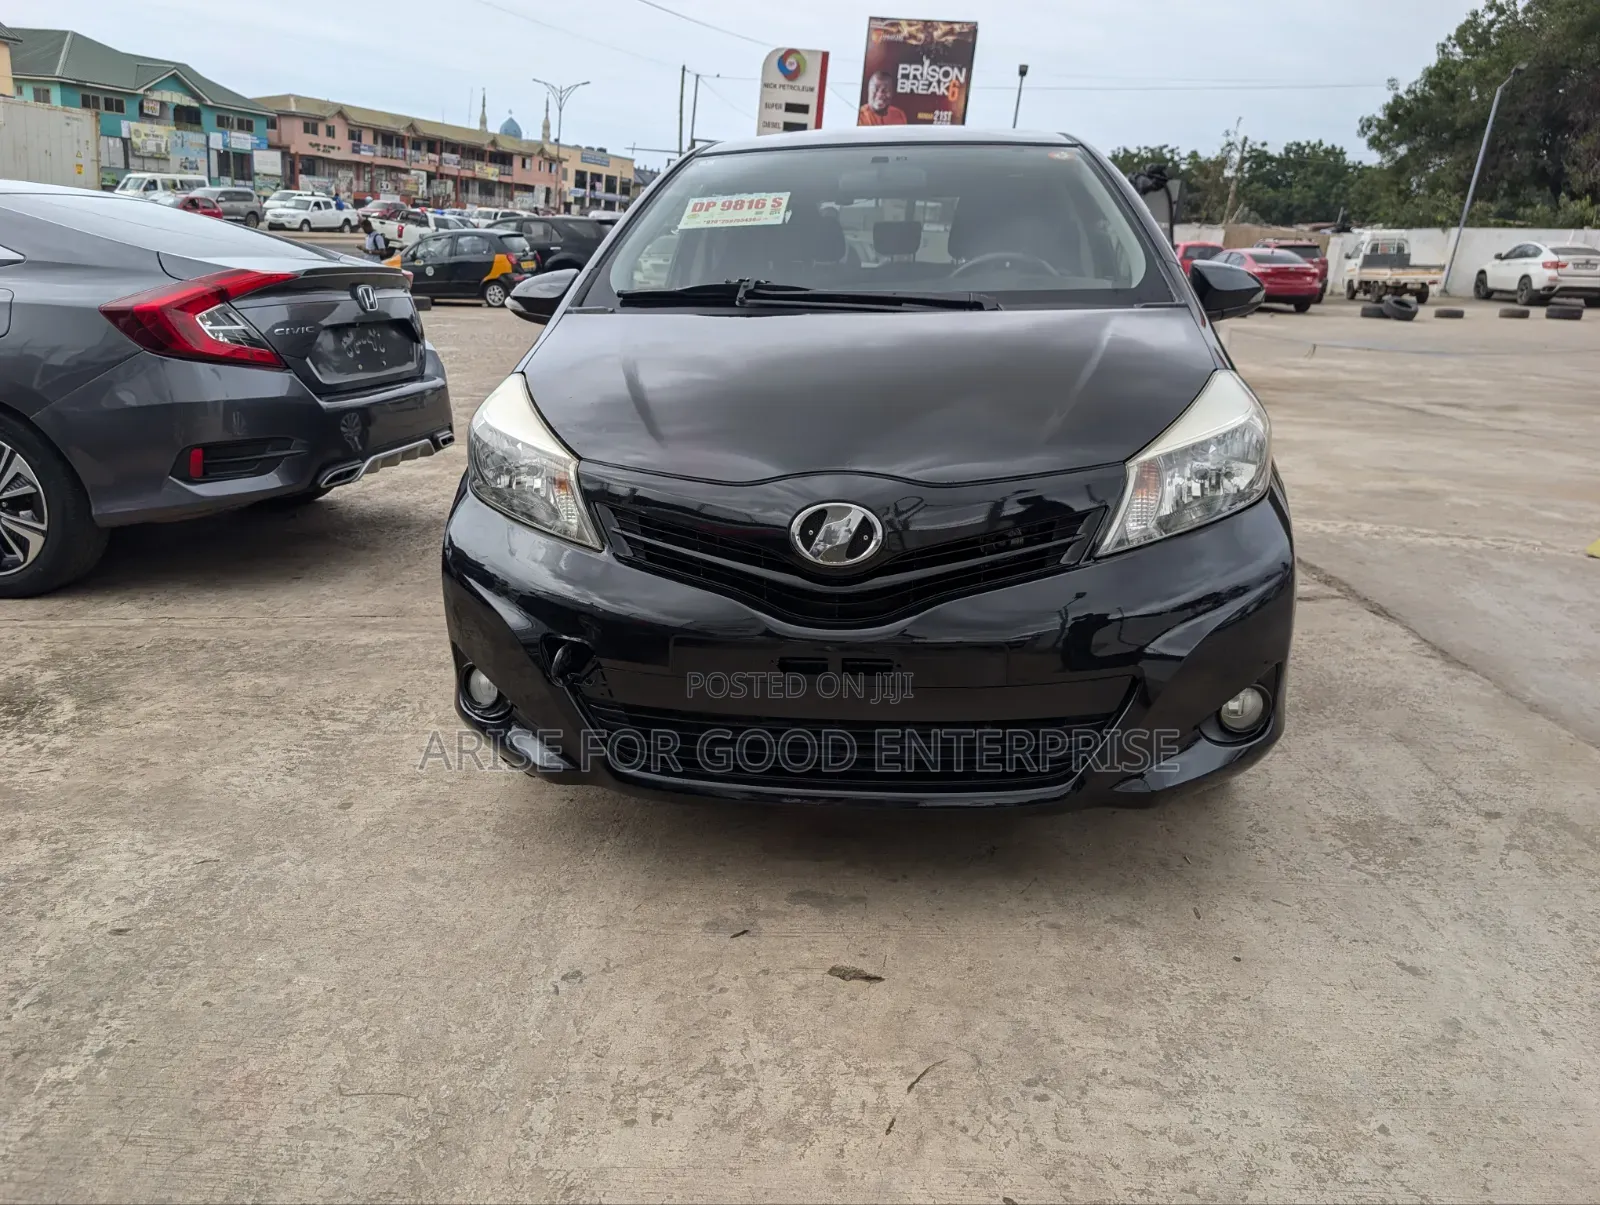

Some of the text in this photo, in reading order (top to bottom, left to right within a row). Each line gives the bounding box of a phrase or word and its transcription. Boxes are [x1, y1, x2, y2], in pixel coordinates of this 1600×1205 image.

[897, 58, 966, 83] PRISON
[764, 102, 783, 110] SUPER
[761, 120, 781, 130] DIESEL
[691, 197, 783, 212] DP 9816 S
[274, 326, 315, 336] CIVIC
